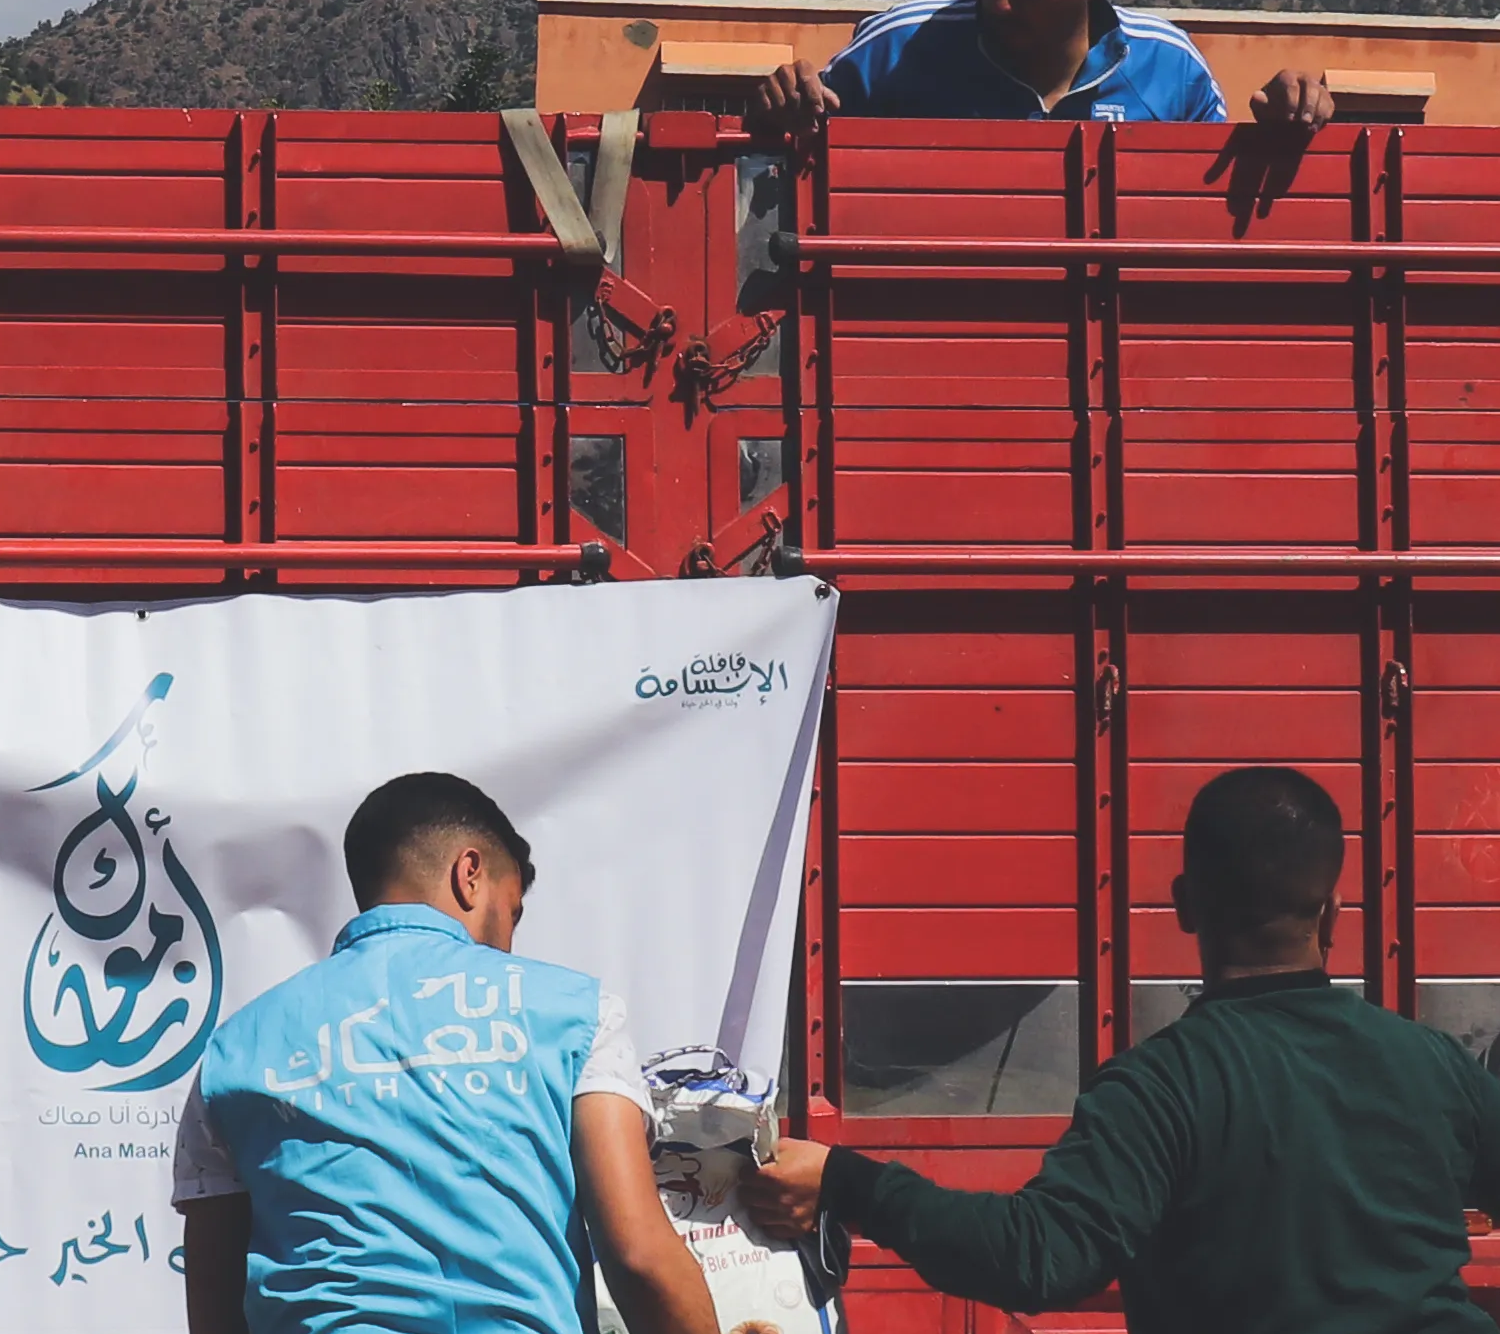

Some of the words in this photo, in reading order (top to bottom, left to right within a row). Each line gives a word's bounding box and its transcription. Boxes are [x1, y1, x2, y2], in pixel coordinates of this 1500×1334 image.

[272, 1077, 399, 1123] WITH
[427, 1070, 528, 1095] YOU
[38, 1105, 102, 1126] معاك
[136, 1105, 184, 1130] ادرة
[73, 1142, 113, 1159] Ana
[118, 1142, 171, 1159] Maak
[48, 1210, 150, 1287] الخير
